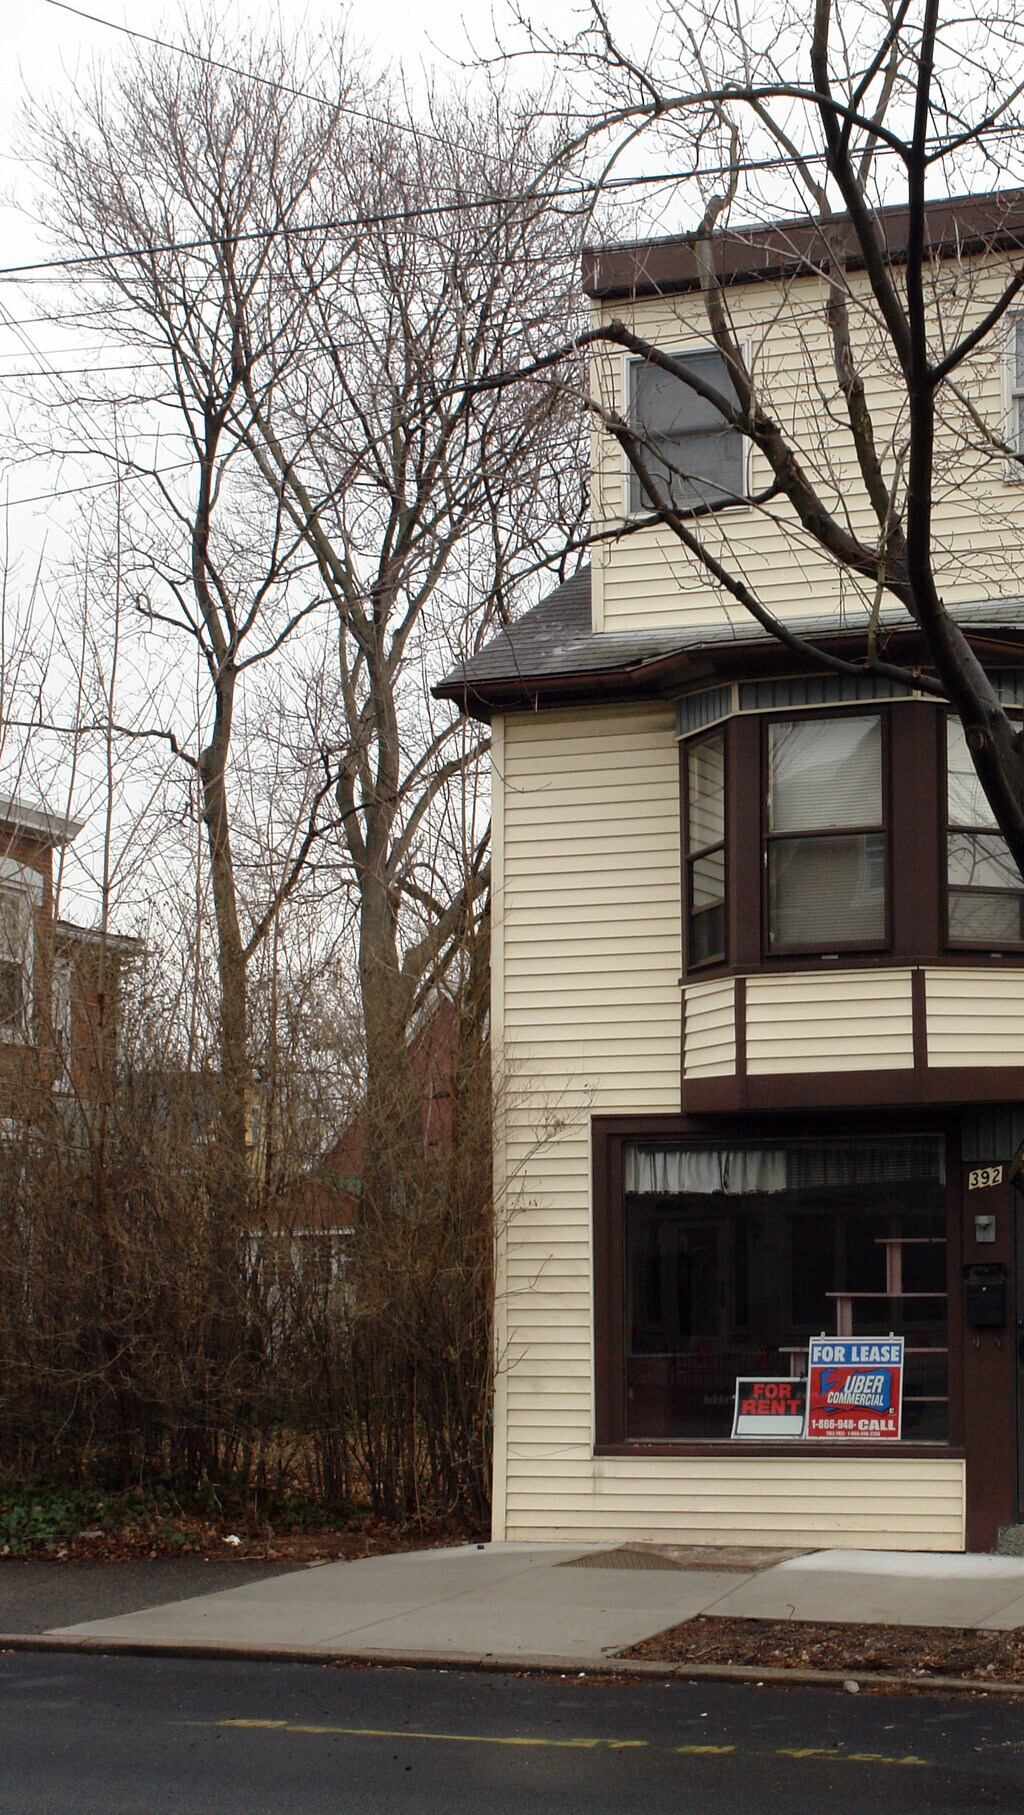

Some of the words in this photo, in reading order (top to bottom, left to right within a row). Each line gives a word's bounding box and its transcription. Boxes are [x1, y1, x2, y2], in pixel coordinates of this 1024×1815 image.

[970, 1168, 1001, 1187] 392
[813, 1346, 846, 1362] FOR
[851, 1345, 900, 1362] LEASE
[753, 1383, 792, 1399] FOR
[827, 1391, 884, 1407] COMMERCIAL
[741, 1400, 800, 1415] RENT
[857, 1418, 896, 1431] CALL
